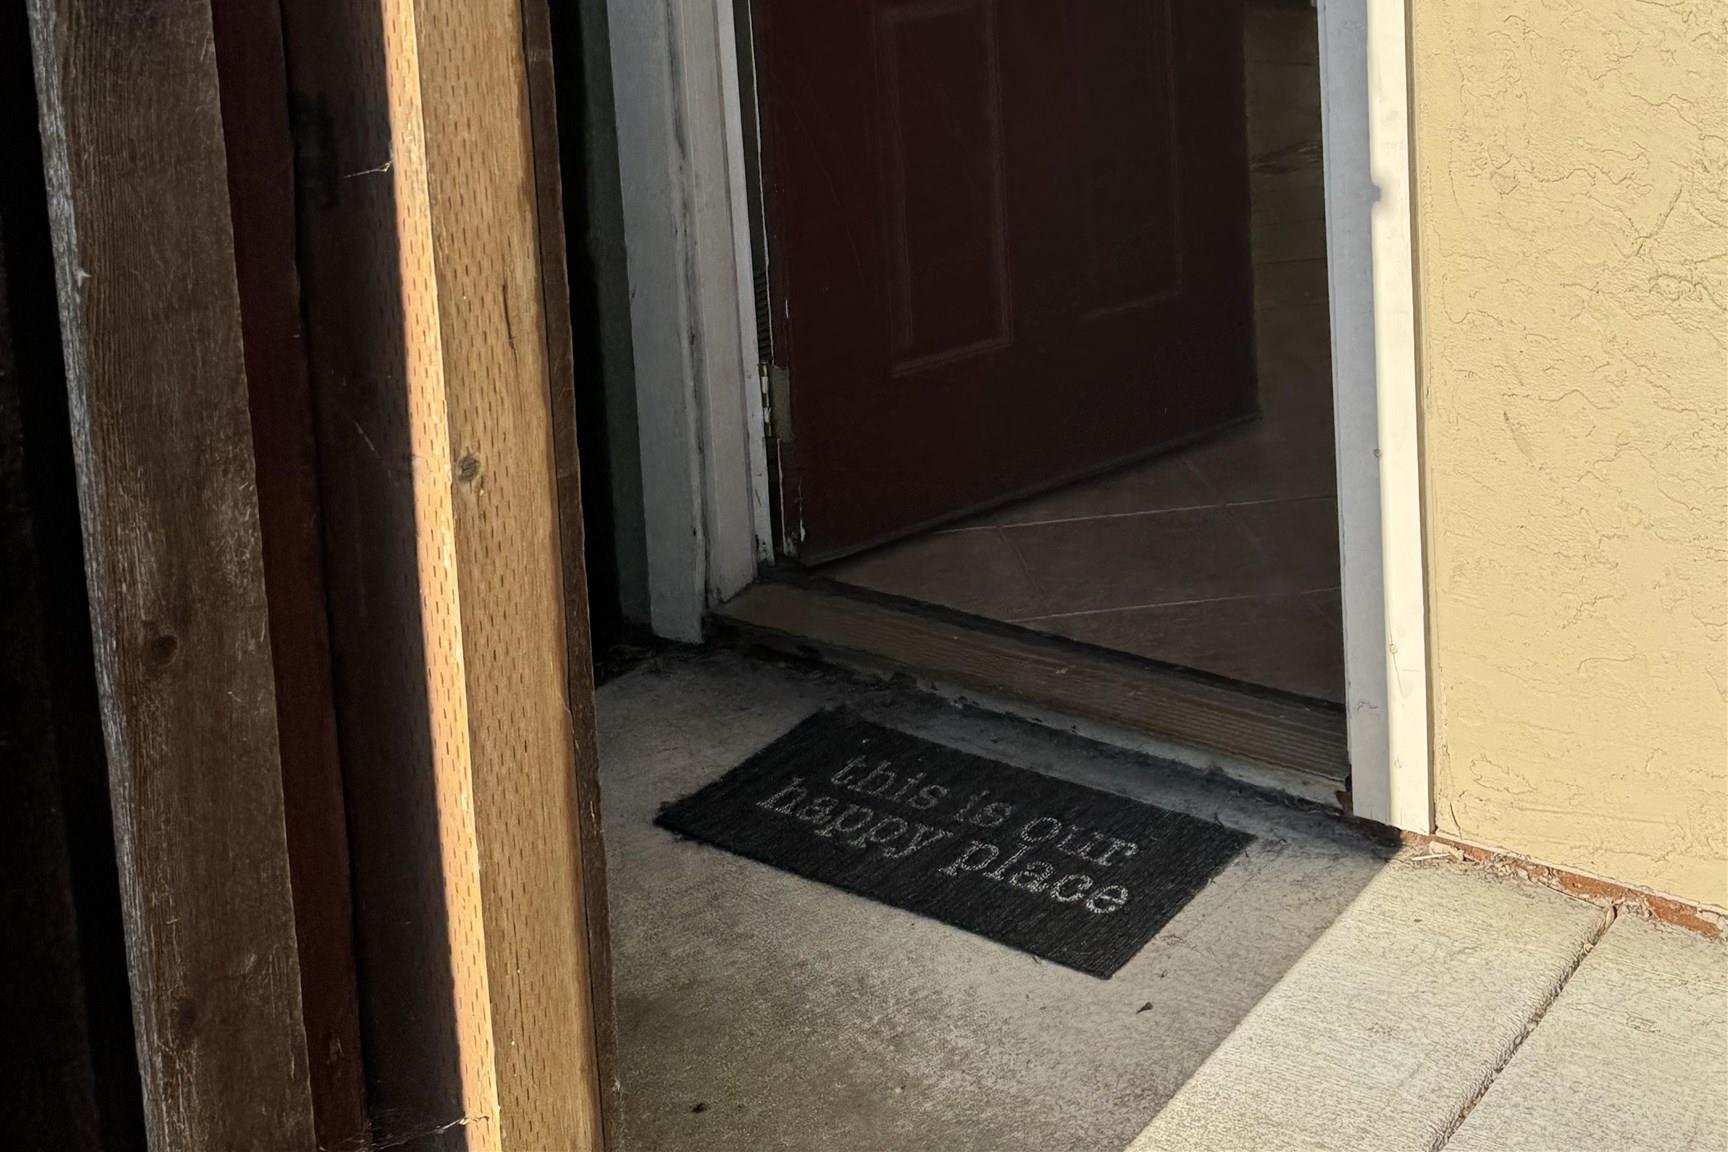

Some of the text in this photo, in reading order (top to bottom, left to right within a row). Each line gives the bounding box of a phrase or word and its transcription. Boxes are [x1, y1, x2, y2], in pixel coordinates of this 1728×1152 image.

[756, 777, 1129, 914] happy place
[831, 755, 1138, 866] this is our
